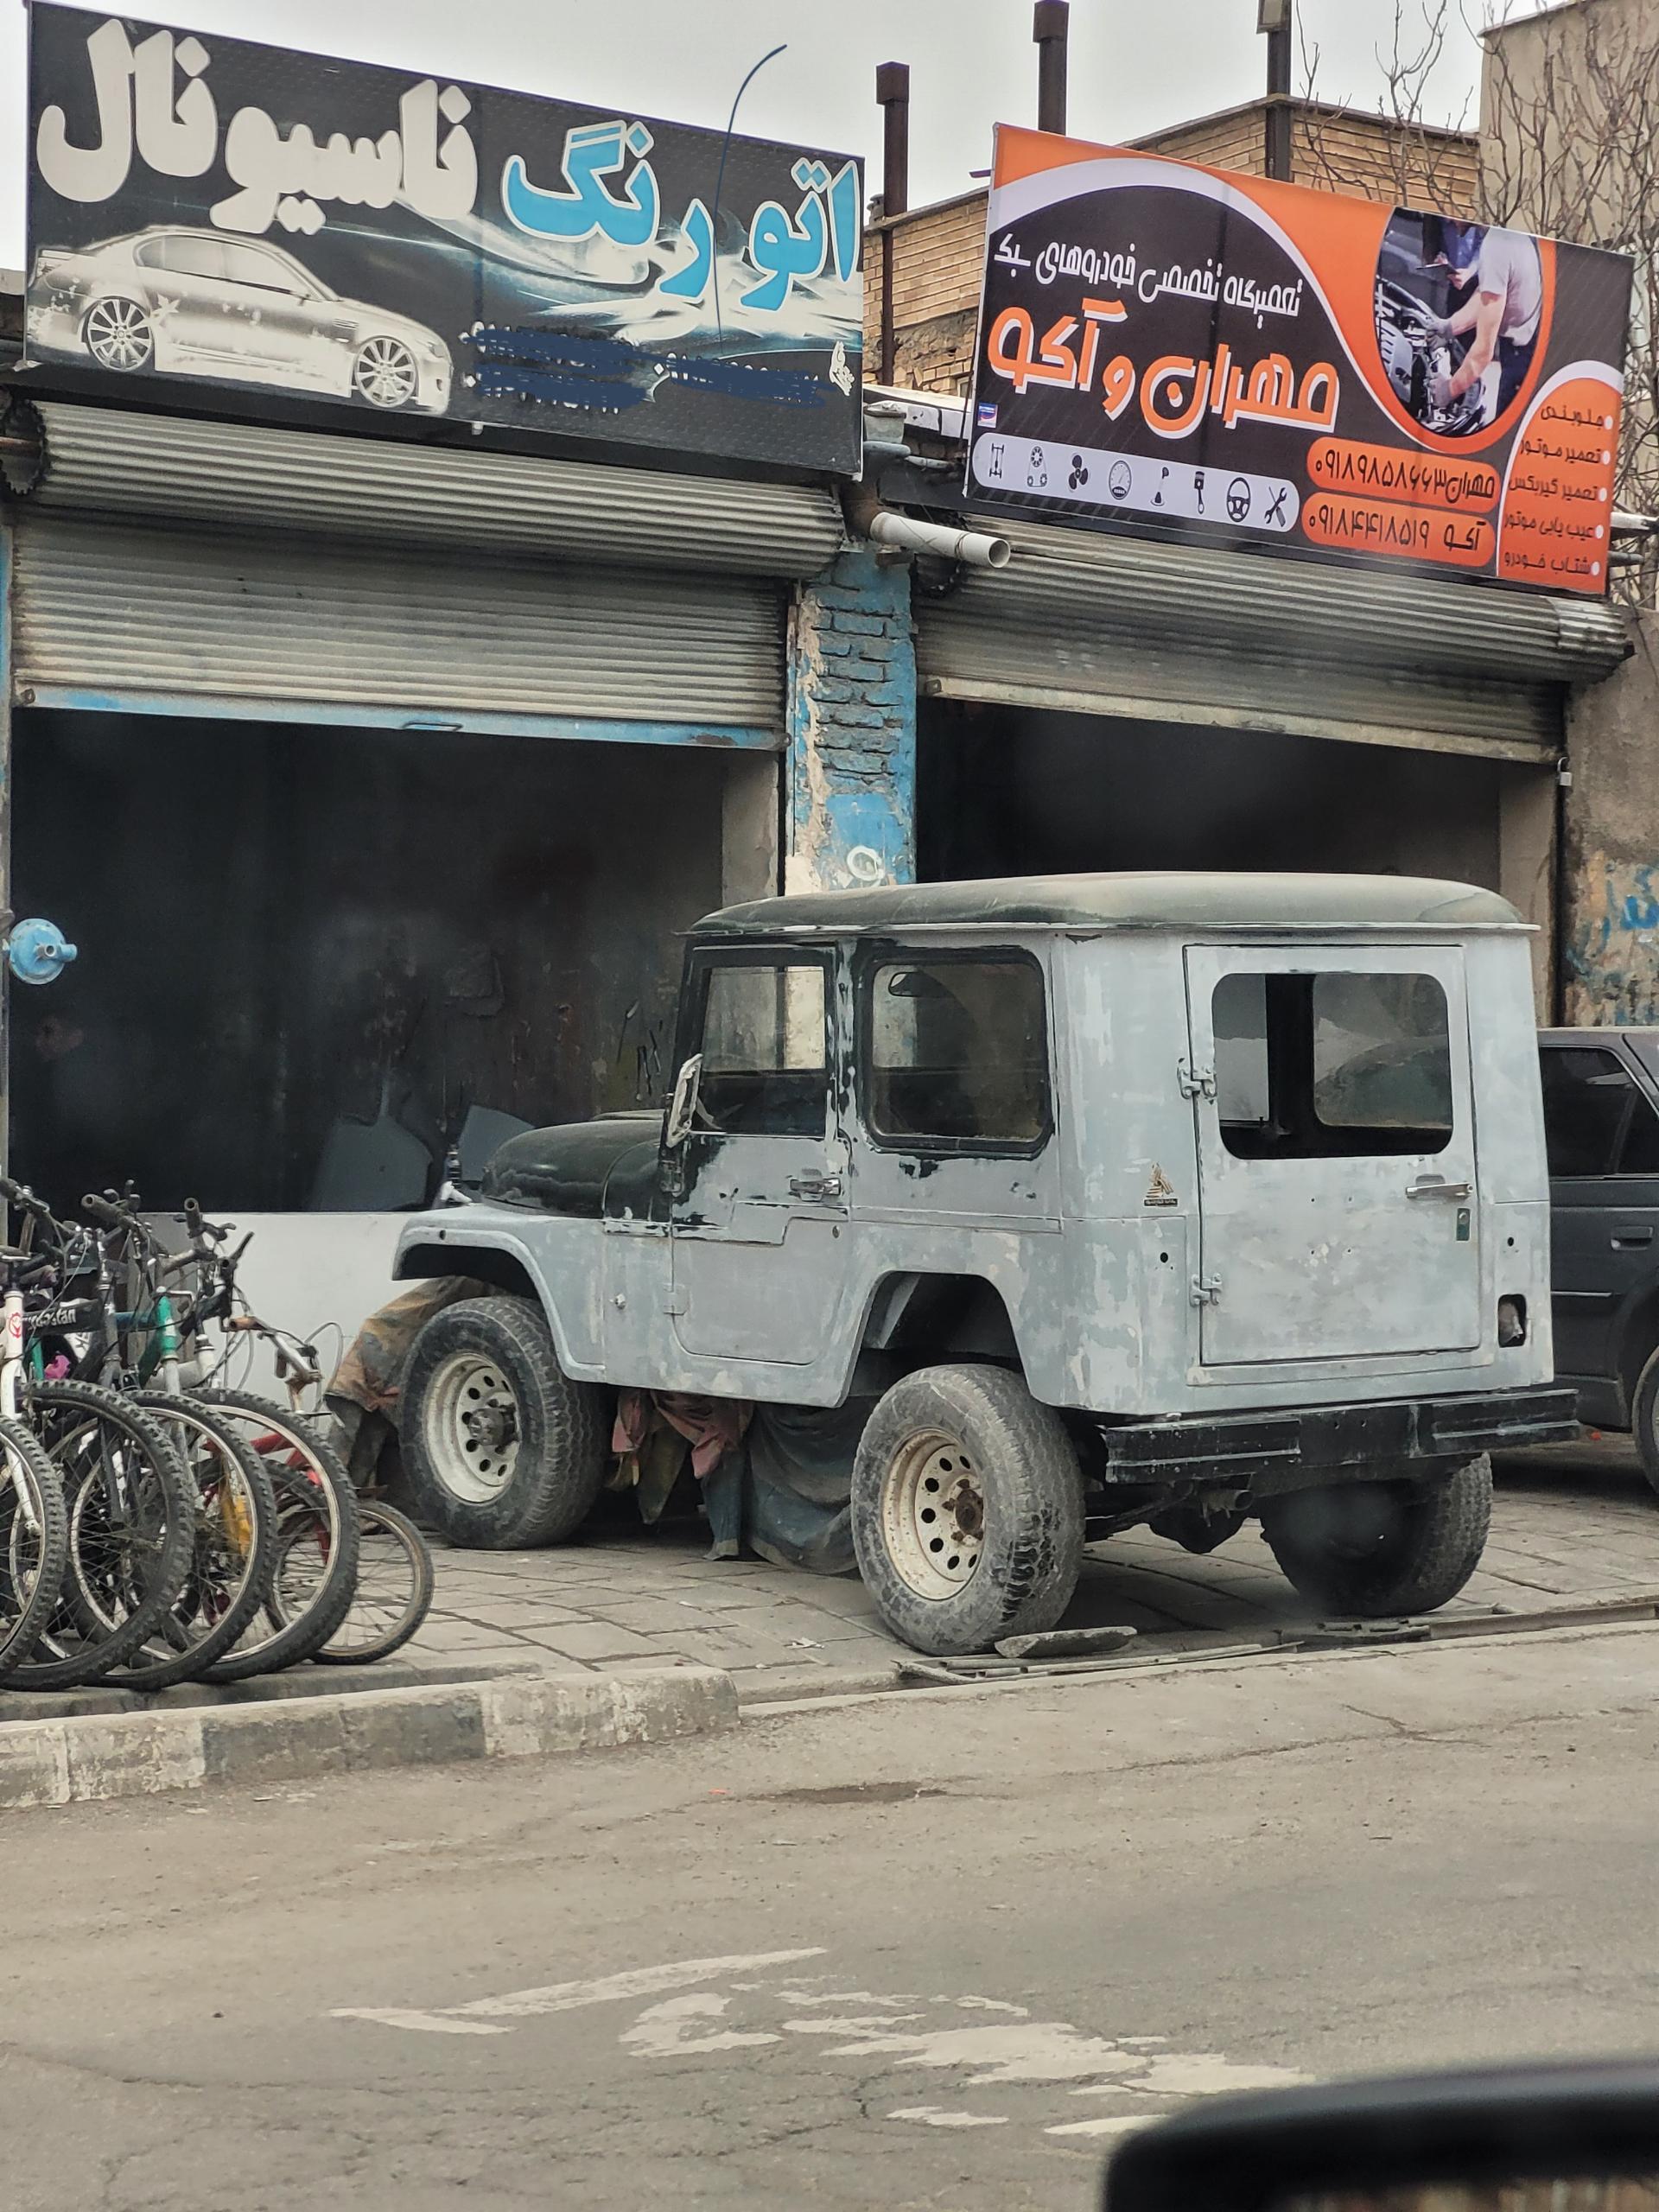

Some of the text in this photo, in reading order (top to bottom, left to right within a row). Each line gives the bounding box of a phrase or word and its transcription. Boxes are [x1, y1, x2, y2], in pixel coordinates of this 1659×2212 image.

[36, 18, 860, 312] اتو رنگ ناسیونال
[1035, 242, 1135, 289] خودروهای
[1138, 258, 1223, 302] تخصصی
[1223, 276, 1303, 329] تعمیرگاه
[988, 297, 1340, 439] مهران و آکو
[1541, 405, 1604, 430] جلوبندی
[1521, 438, 1601, 464] تعمیر موتور
[1446, 472, 1495, 503] مهران
[1509, 475, 1598, 501] تعمیر گیربکس
[1309, 505, 1486, 551] آکو ۰۹۱۸۴۴۱۸۵۱۹
[1504, 511, 1594, 541] عیب یابی موتور
[1504, 551, 1591, 574] شتاب خودرو
